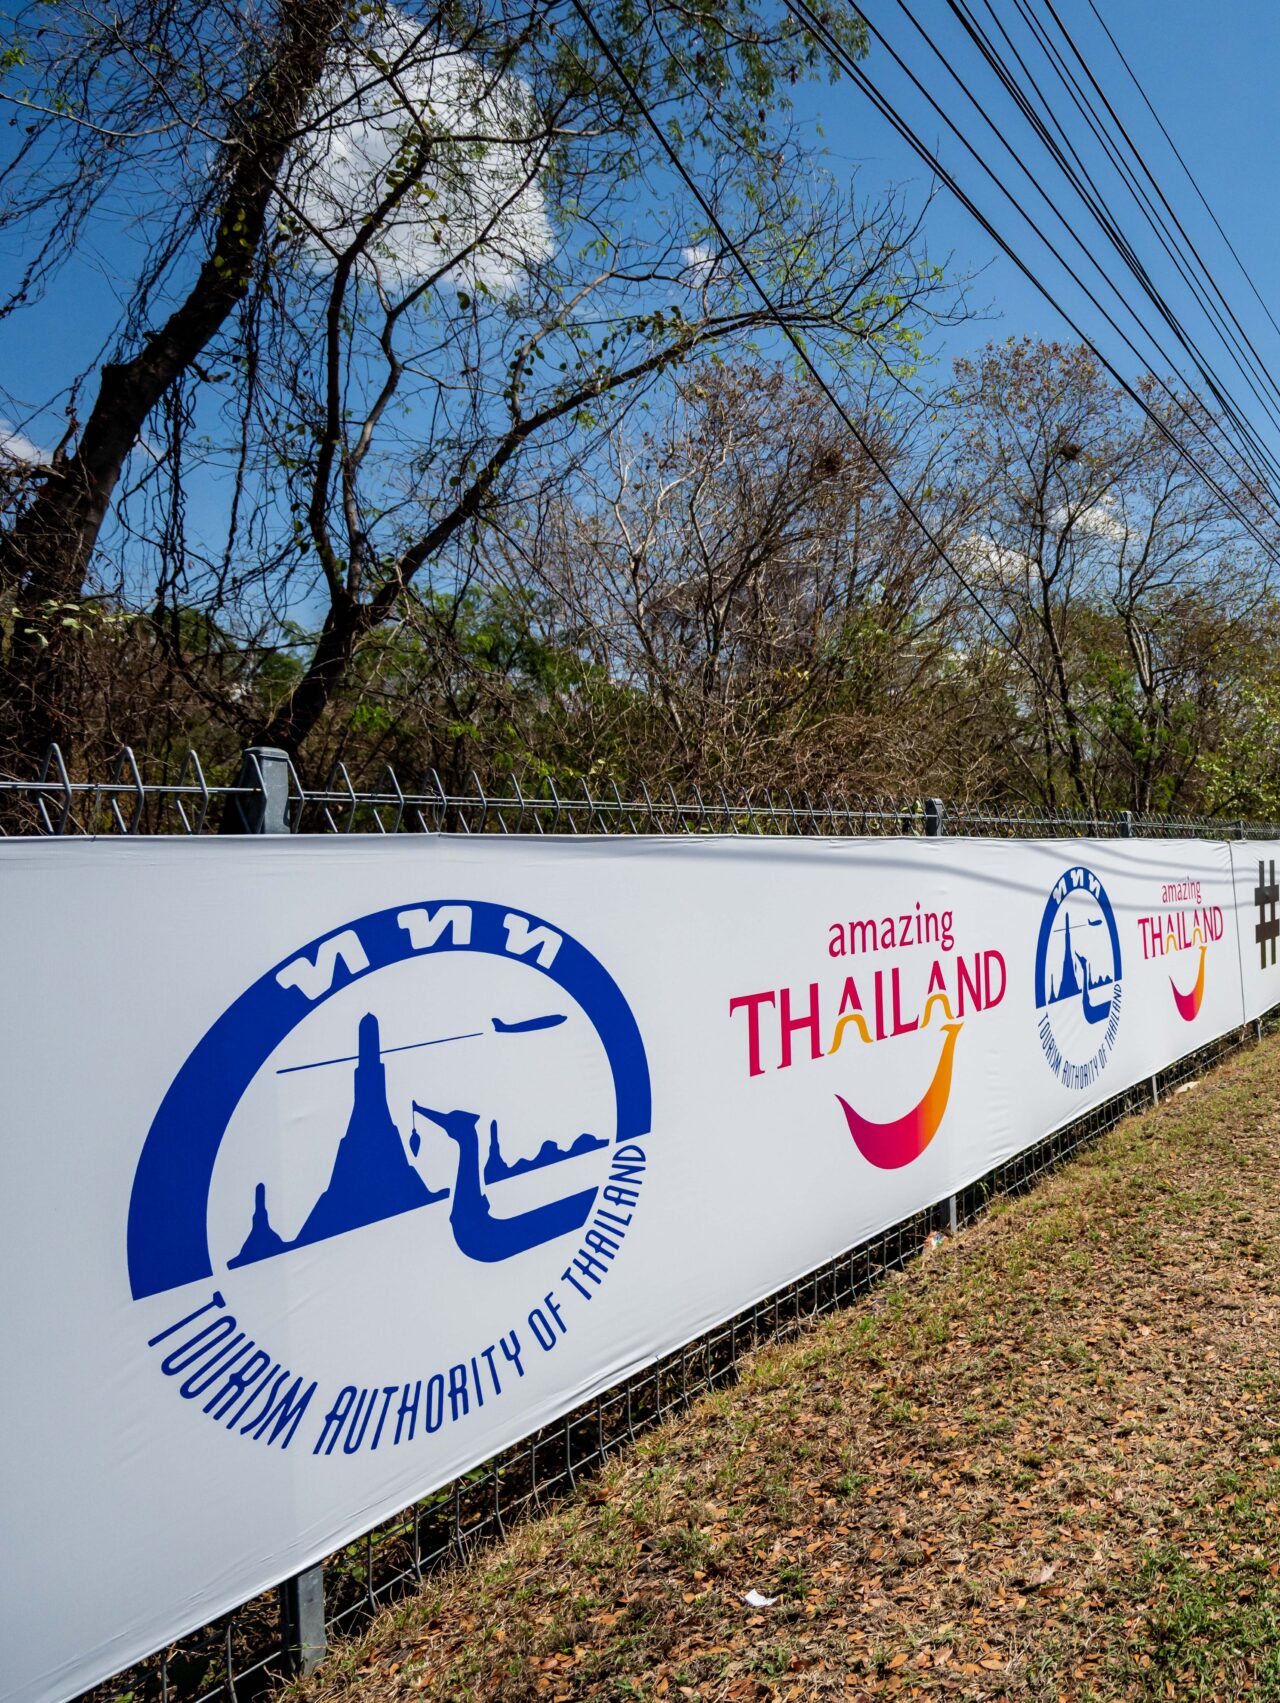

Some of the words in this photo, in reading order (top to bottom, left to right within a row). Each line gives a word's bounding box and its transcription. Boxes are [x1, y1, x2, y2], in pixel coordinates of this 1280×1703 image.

[828, 901, 955, 957] amazing
[1137, 906, 1223, 959] THAILAND
[1162, 876, 1201, 904] amazing
[275, 905, 563, 1000] ททท
[729, 950, 1007, 1077] THAILAND
[1038, 1012, 1062, 1078] TOURISM
[1062, 1056, 1099, 1089] AUTHORITY
[1098, 1044, 1107, 1069] OF
[1105, 983, 1122, 1051] THAILAND
[148, 1291, 318, 1450] TOURISM
[312, 1330, 526, 1455] AUTHORITY
[528, 1291, 568, 1352] OF
[560, 1144, 647, 1300] THAILAND
